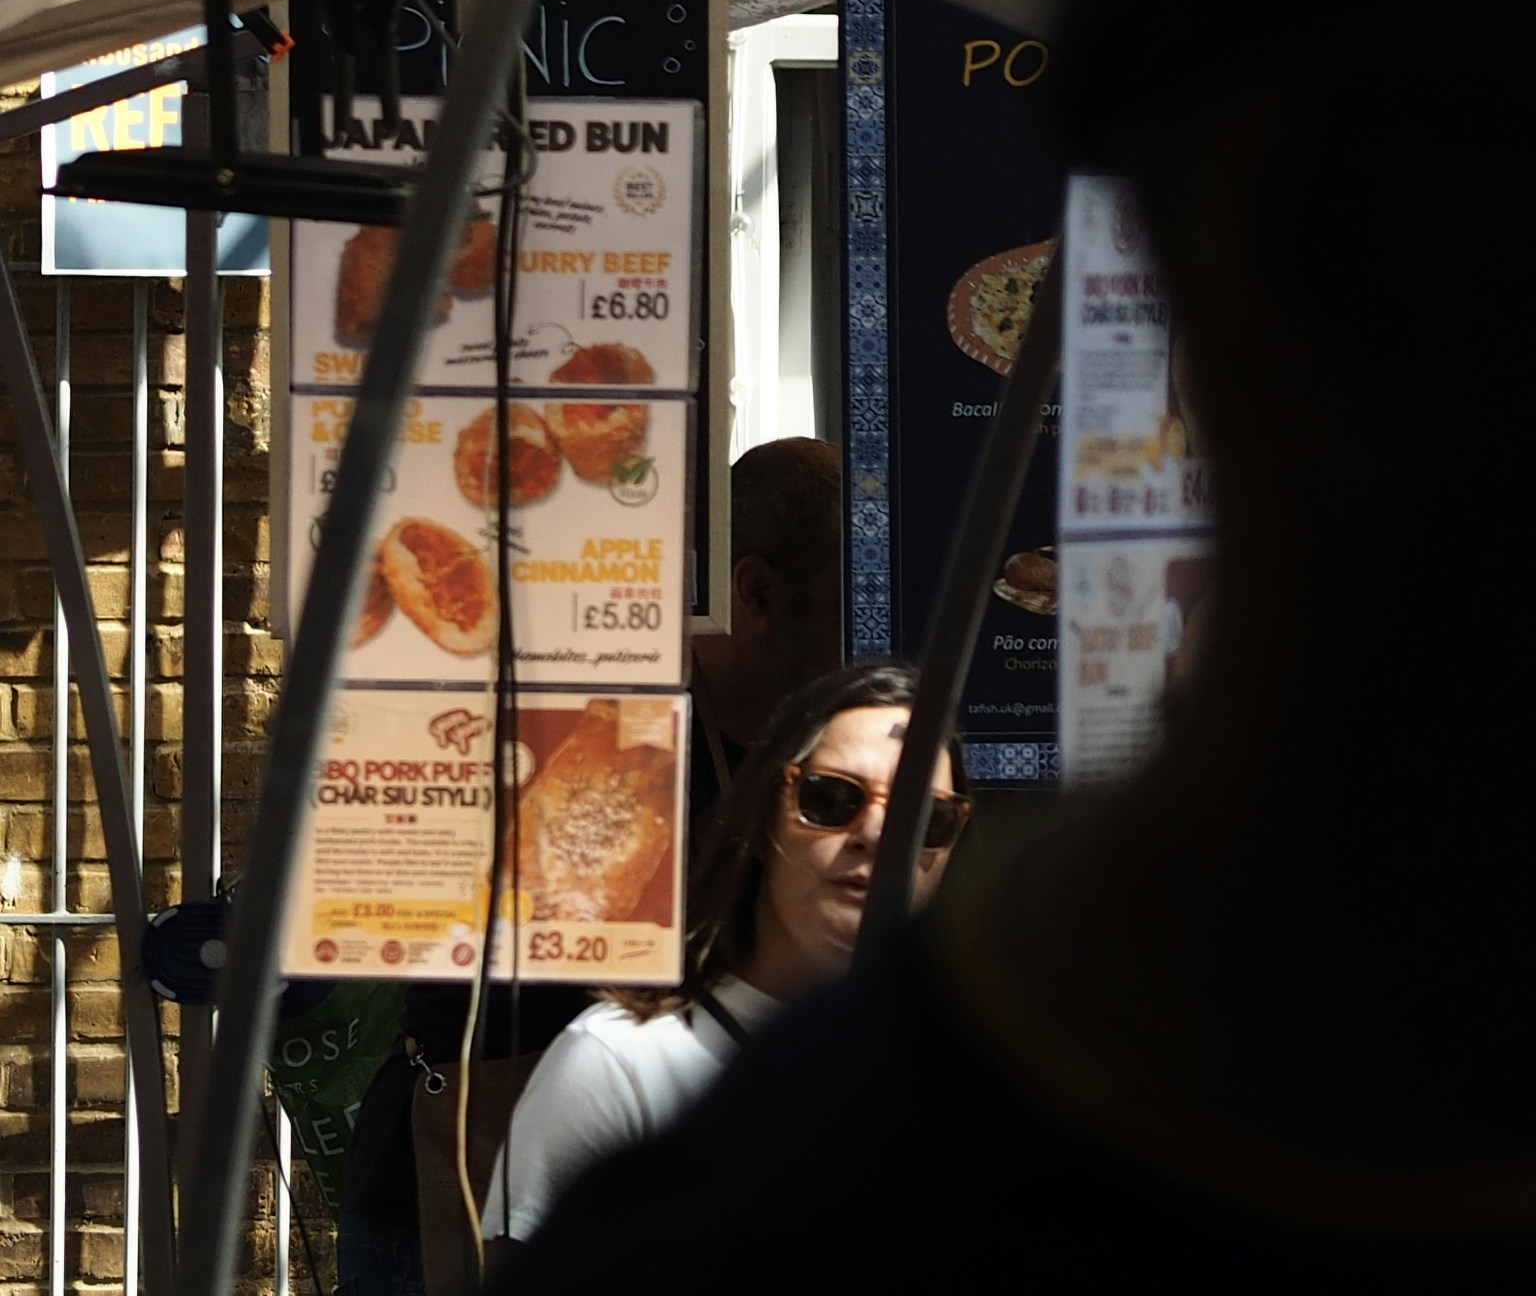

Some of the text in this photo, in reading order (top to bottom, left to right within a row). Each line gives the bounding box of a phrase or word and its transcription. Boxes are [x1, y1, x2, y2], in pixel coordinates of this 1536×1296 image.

[585, 120, 670, 154] BUN
[517, 250, 672, 275] URRY BEEF
[590, 291, 670, 321] £6.80
[580, 537, 664, 560] APPLE
[511, 560, 661, 584] CINNAMON
[583, 601, 663, 632] £5.80
[993, 635, 1025, 651] Pão
[364, 760, 427, 782] PORK
[383, 785, 418, 807] SIU
[527, 931, 609, 962] £3.20
